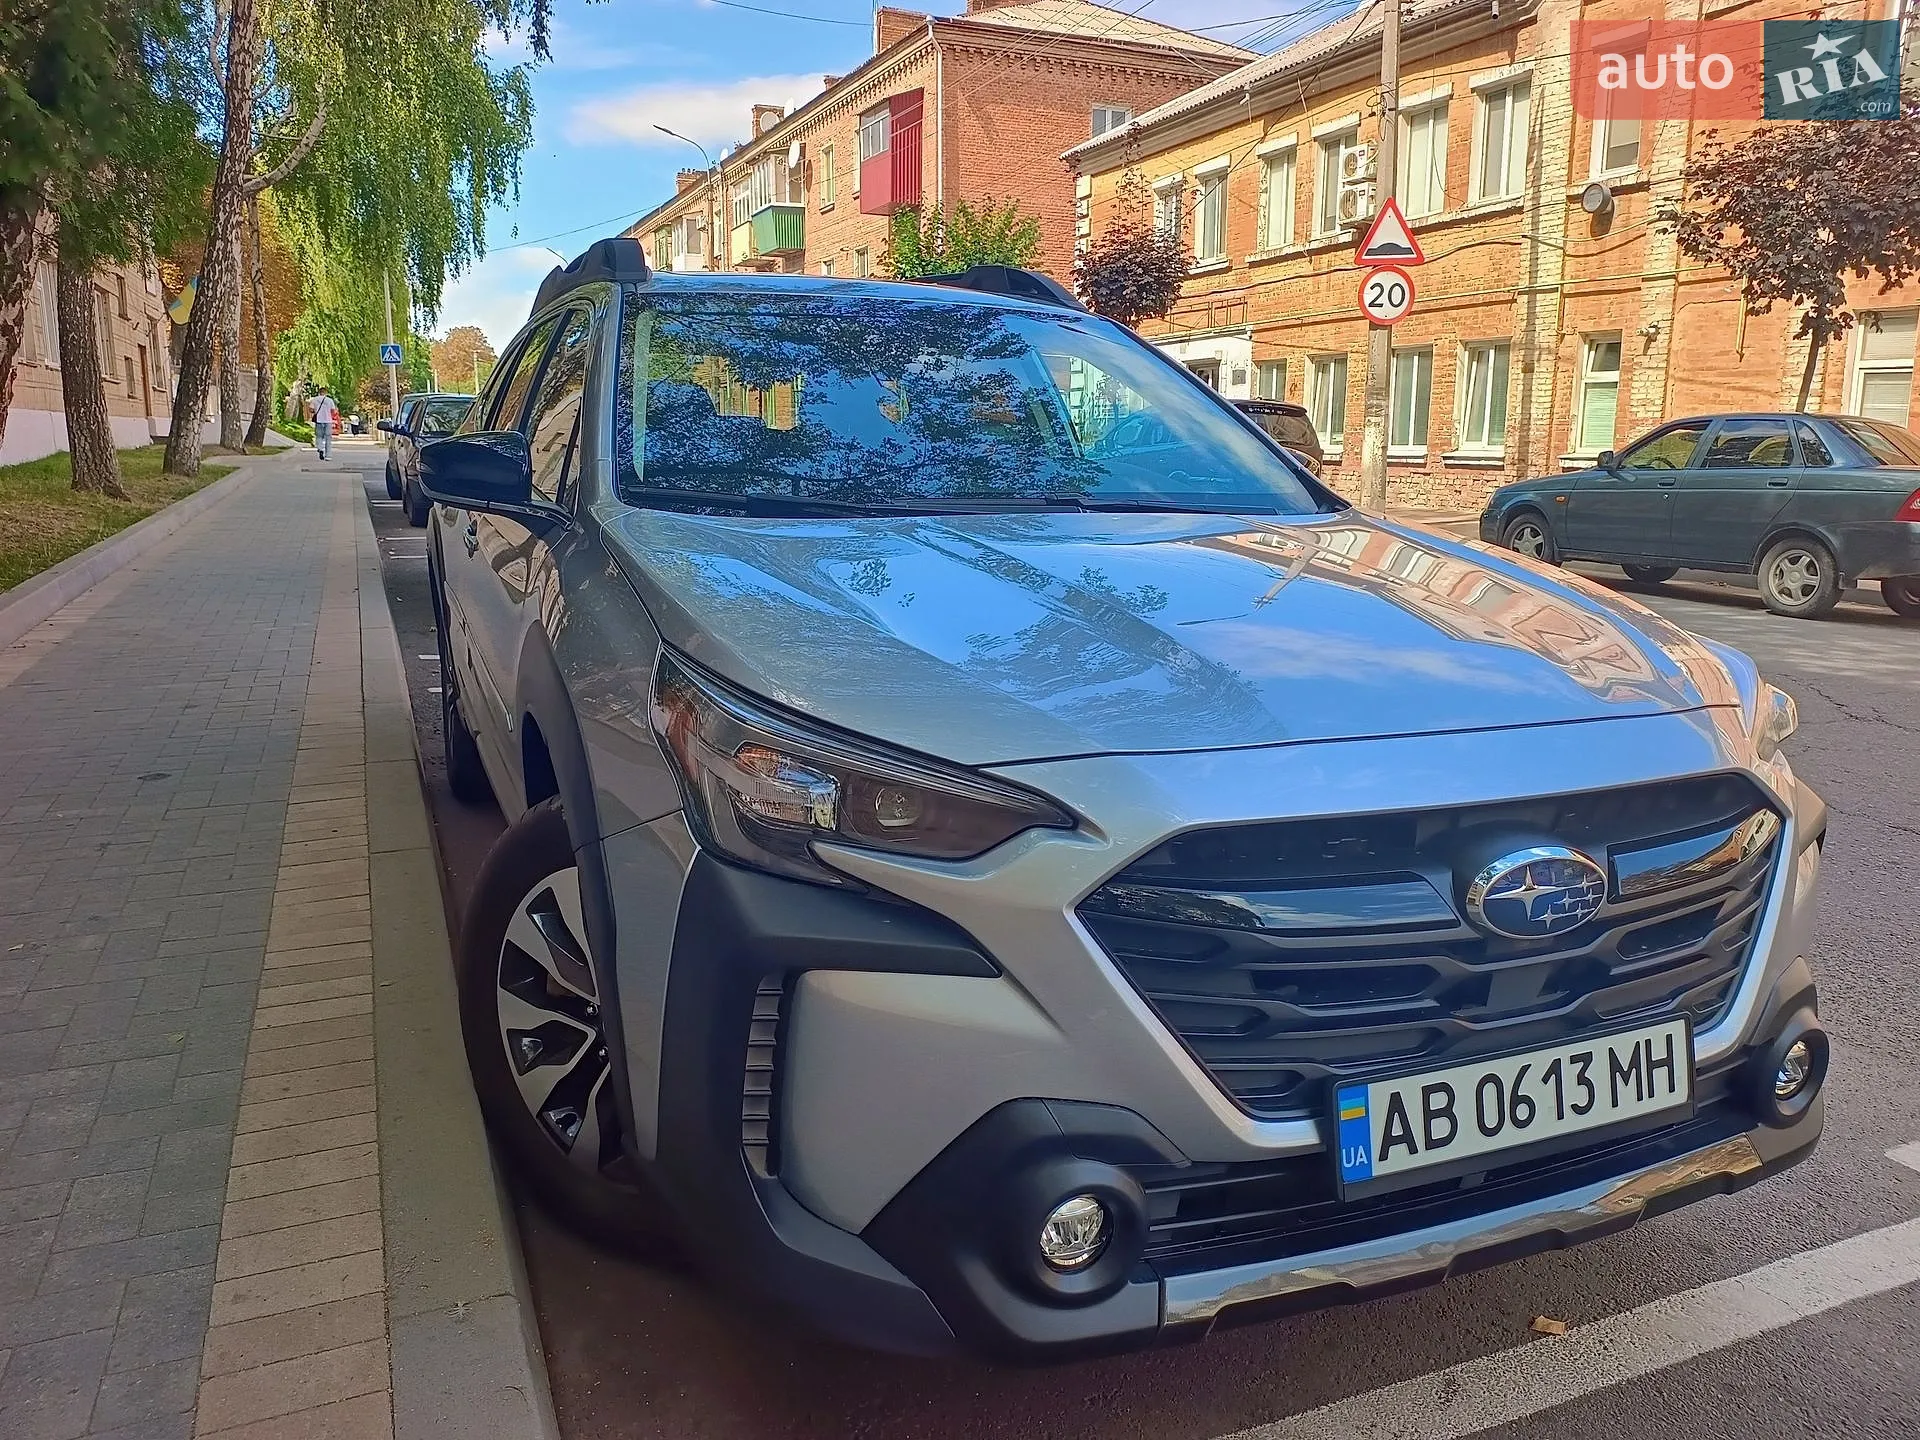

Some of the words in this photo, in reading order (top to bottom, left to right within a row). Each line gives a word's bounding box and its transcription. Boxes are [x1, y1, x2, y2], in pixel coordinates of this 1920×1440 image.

[1368, 282, 1406, 308] 20
[1378, 1081, 1459, 1162] AB
[1475, 1050, 1596, 1138] 0613
[1608, 1033, 1676, 1108] MH
[1342, 1143, 1368, 1168] UA
